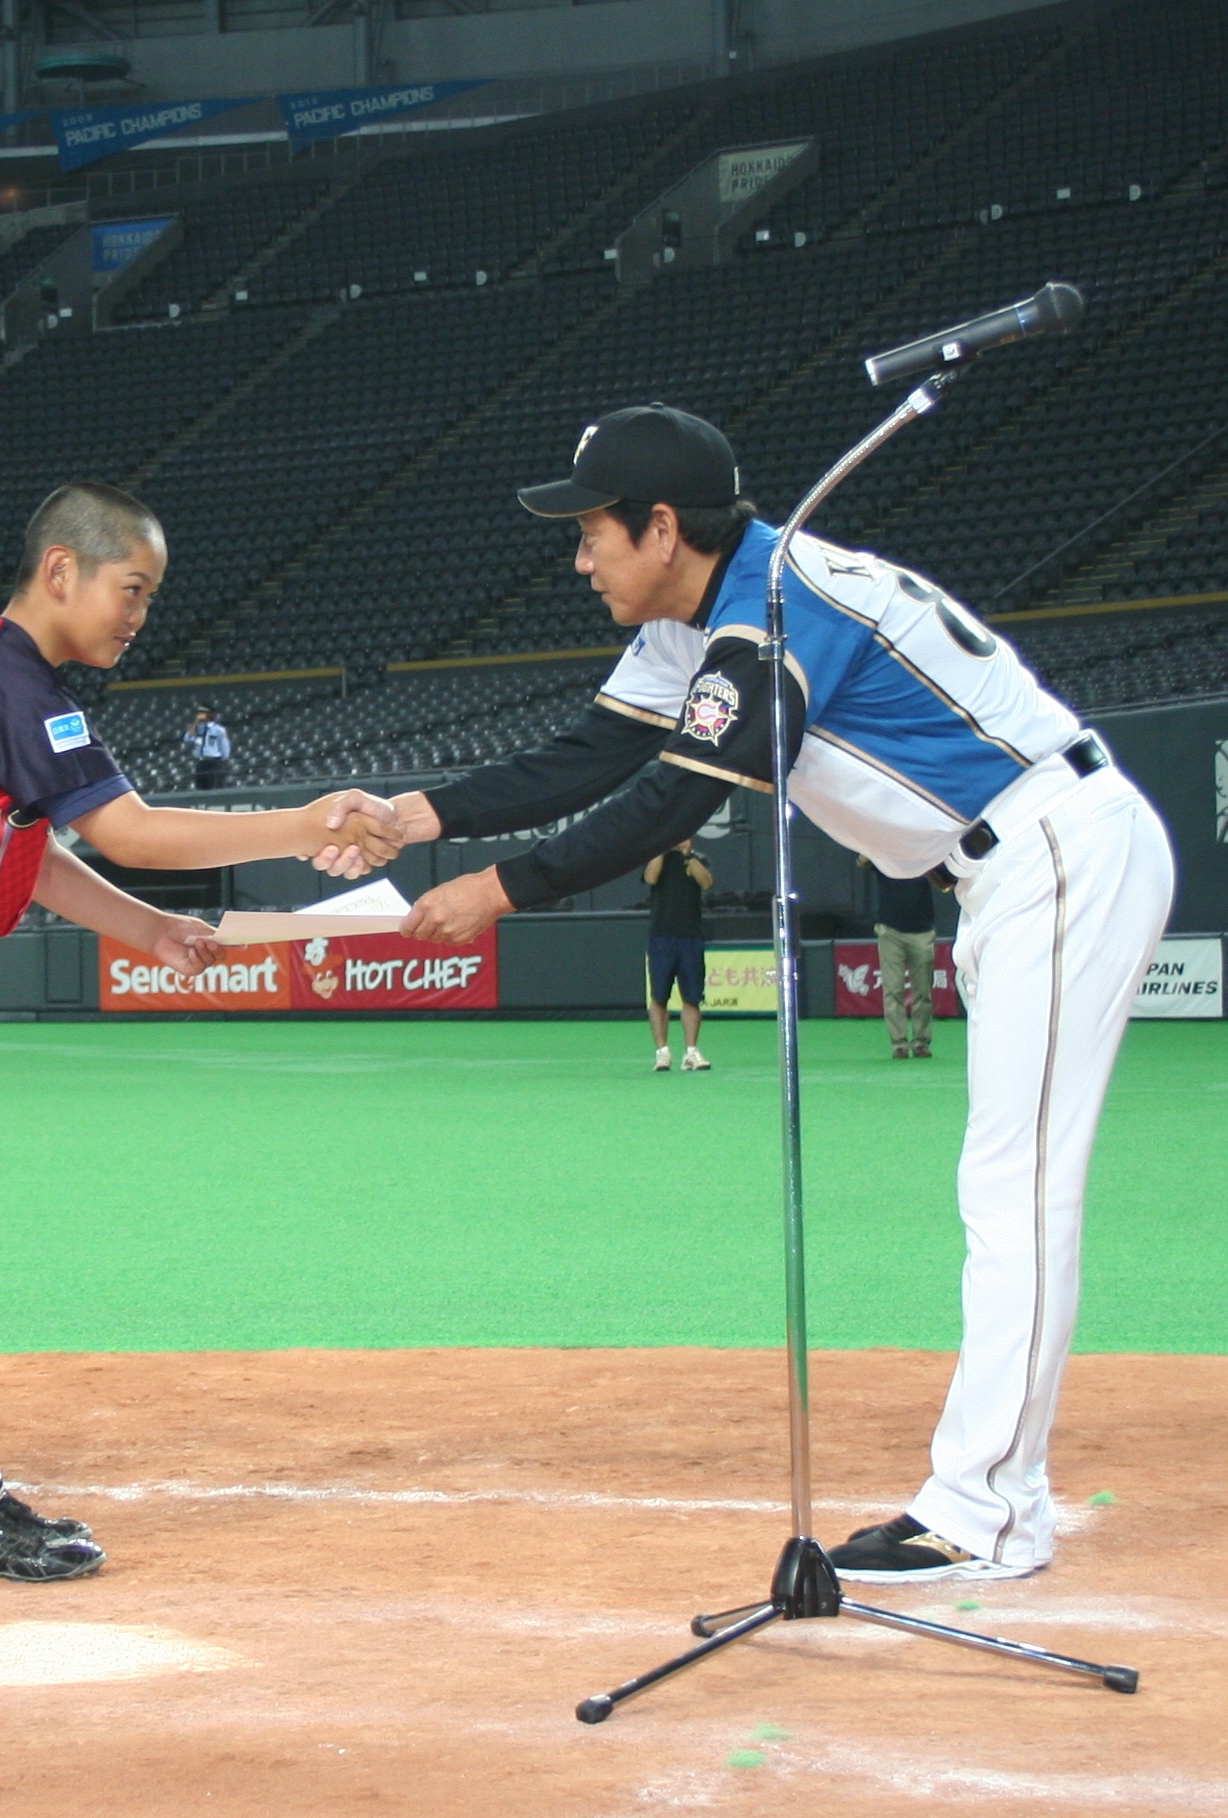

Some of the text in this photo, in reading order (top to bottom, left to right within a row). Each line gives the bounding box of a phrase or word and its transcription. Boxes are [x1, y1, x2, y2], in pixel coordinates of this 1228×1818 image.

[65, 103, 202, 147] PACIFIC CHAMPIONS
[294, 86, 434, 129] PACIFIC CHAMPIONS
[345, 956, 482, 991] HOT CHEF
[1137, 981, 1218, 995] IRLINES
